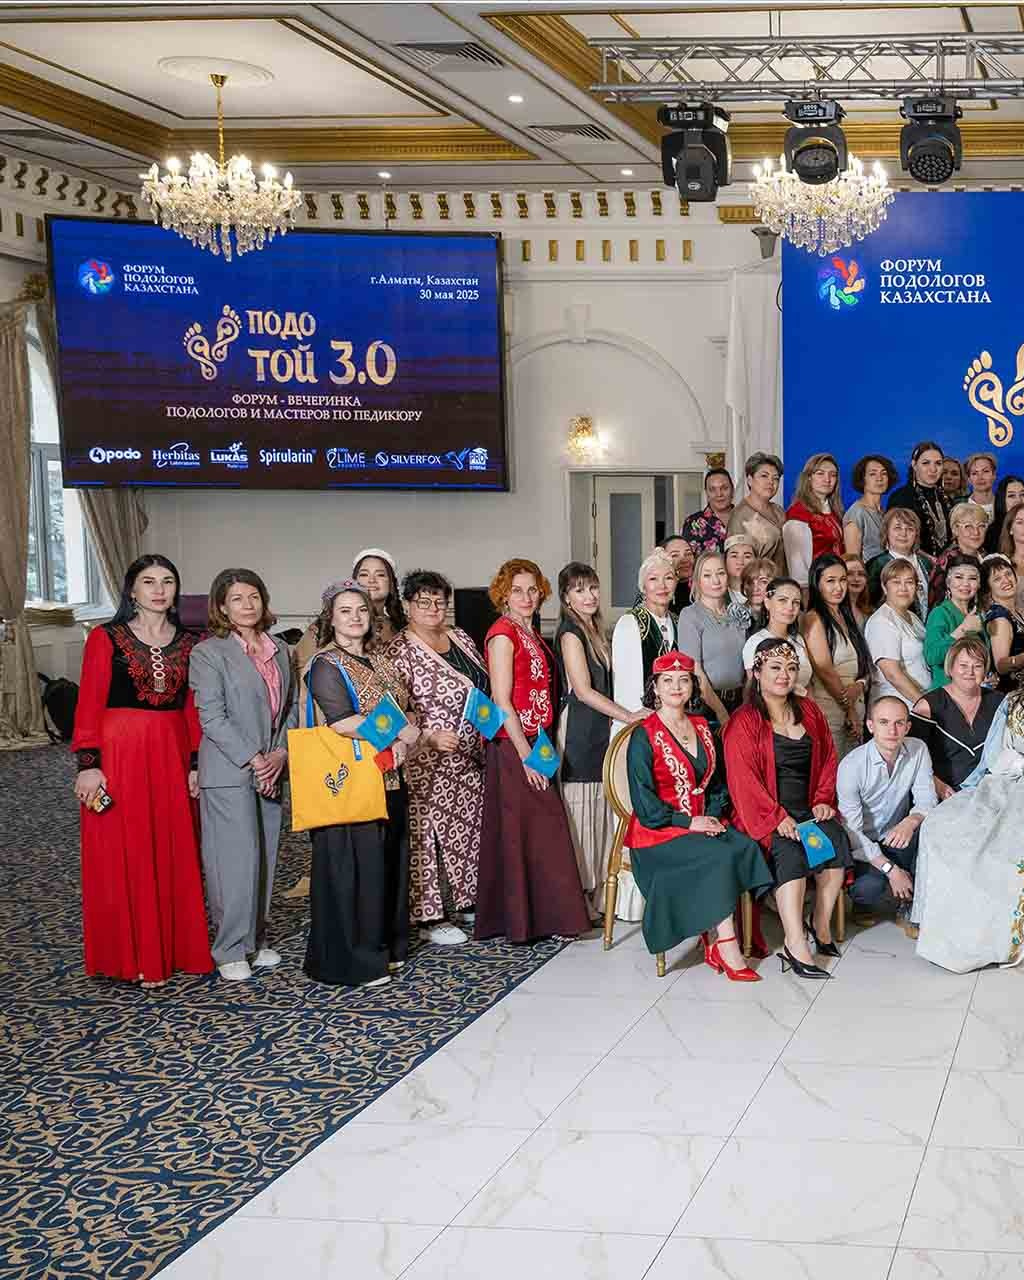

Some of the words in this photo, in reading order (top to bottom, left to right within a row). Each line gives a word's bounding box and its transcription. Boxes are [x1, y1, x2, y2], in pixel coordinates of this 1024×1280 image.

[123, 264, 165, 274] ФОРУМ
[880, 260, 941, 272] ФОРУМ
[124, 273, 194, 284] ПОДОЛОГОВ
[427, 275, 479, 286] Казахстан
[881, 275, 984, 289] ПОДОЛОГОВ
[124, 283, 199, 294] КАЗАХСТАНА
[420, 289, 432, 300] 30
[434, 291, 454, 300] мая
[456, 290, 480, 301] 2025
[881, 291, 991, 303] КАЗАХСТАНА
[247, 310, 316, 340] ПОДО
[248, 340, 318, 384] ТОЙ
[329, 340, 396, 385] 3.0
[232, 394, 278, 406] ФОРУМ
[288, 396, 361, 407] ВЕЧЕРИНКА
[166, 406, 247, 419] ПОДОЛОГОВ
[250, 408, 261, 418] И
[263, 408, 330, 420] МАСТЕРОВ
[333, 410, 351, 420] ПО
[354, 410, 422, 422] ПЕДИКЮРУ
[152, 449, 200, 461] Herbitas
[391, 455, 441, 465] SILVERFOX
